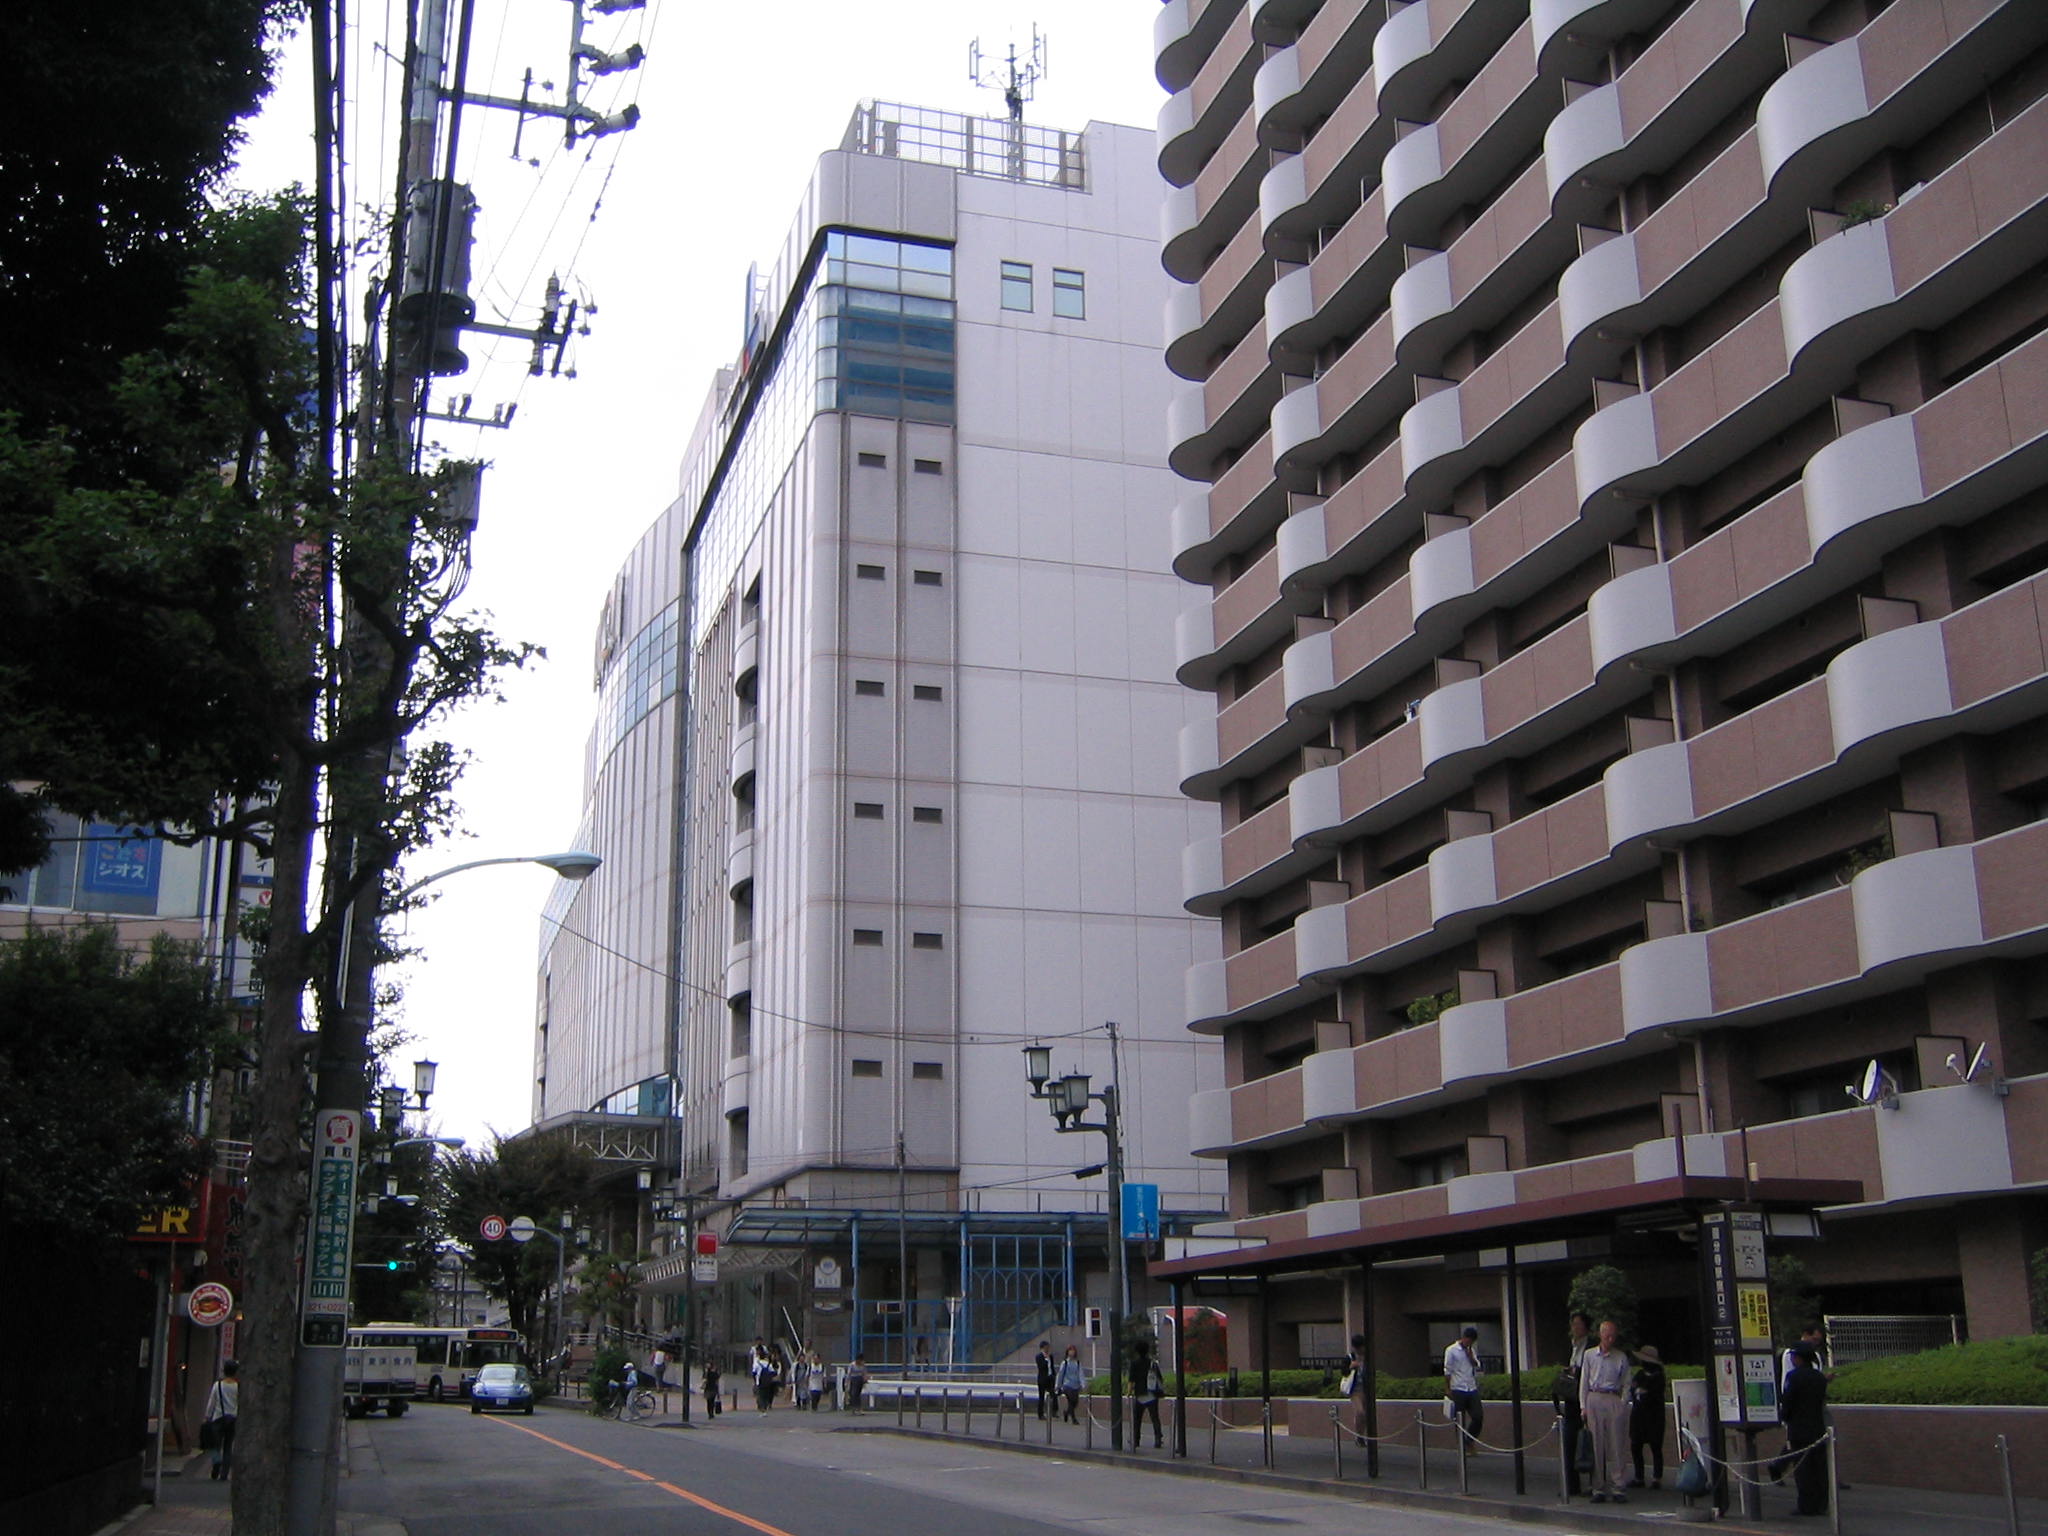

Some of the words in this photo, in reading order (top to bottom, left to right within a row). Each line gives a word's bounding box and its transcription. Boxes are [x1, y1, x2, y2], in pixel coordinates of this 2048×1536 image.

[98, 862, 145, 880] ジオス
[485, 1222, 500, 1234] 40
[312, 1282, 344, 1297] 山川
